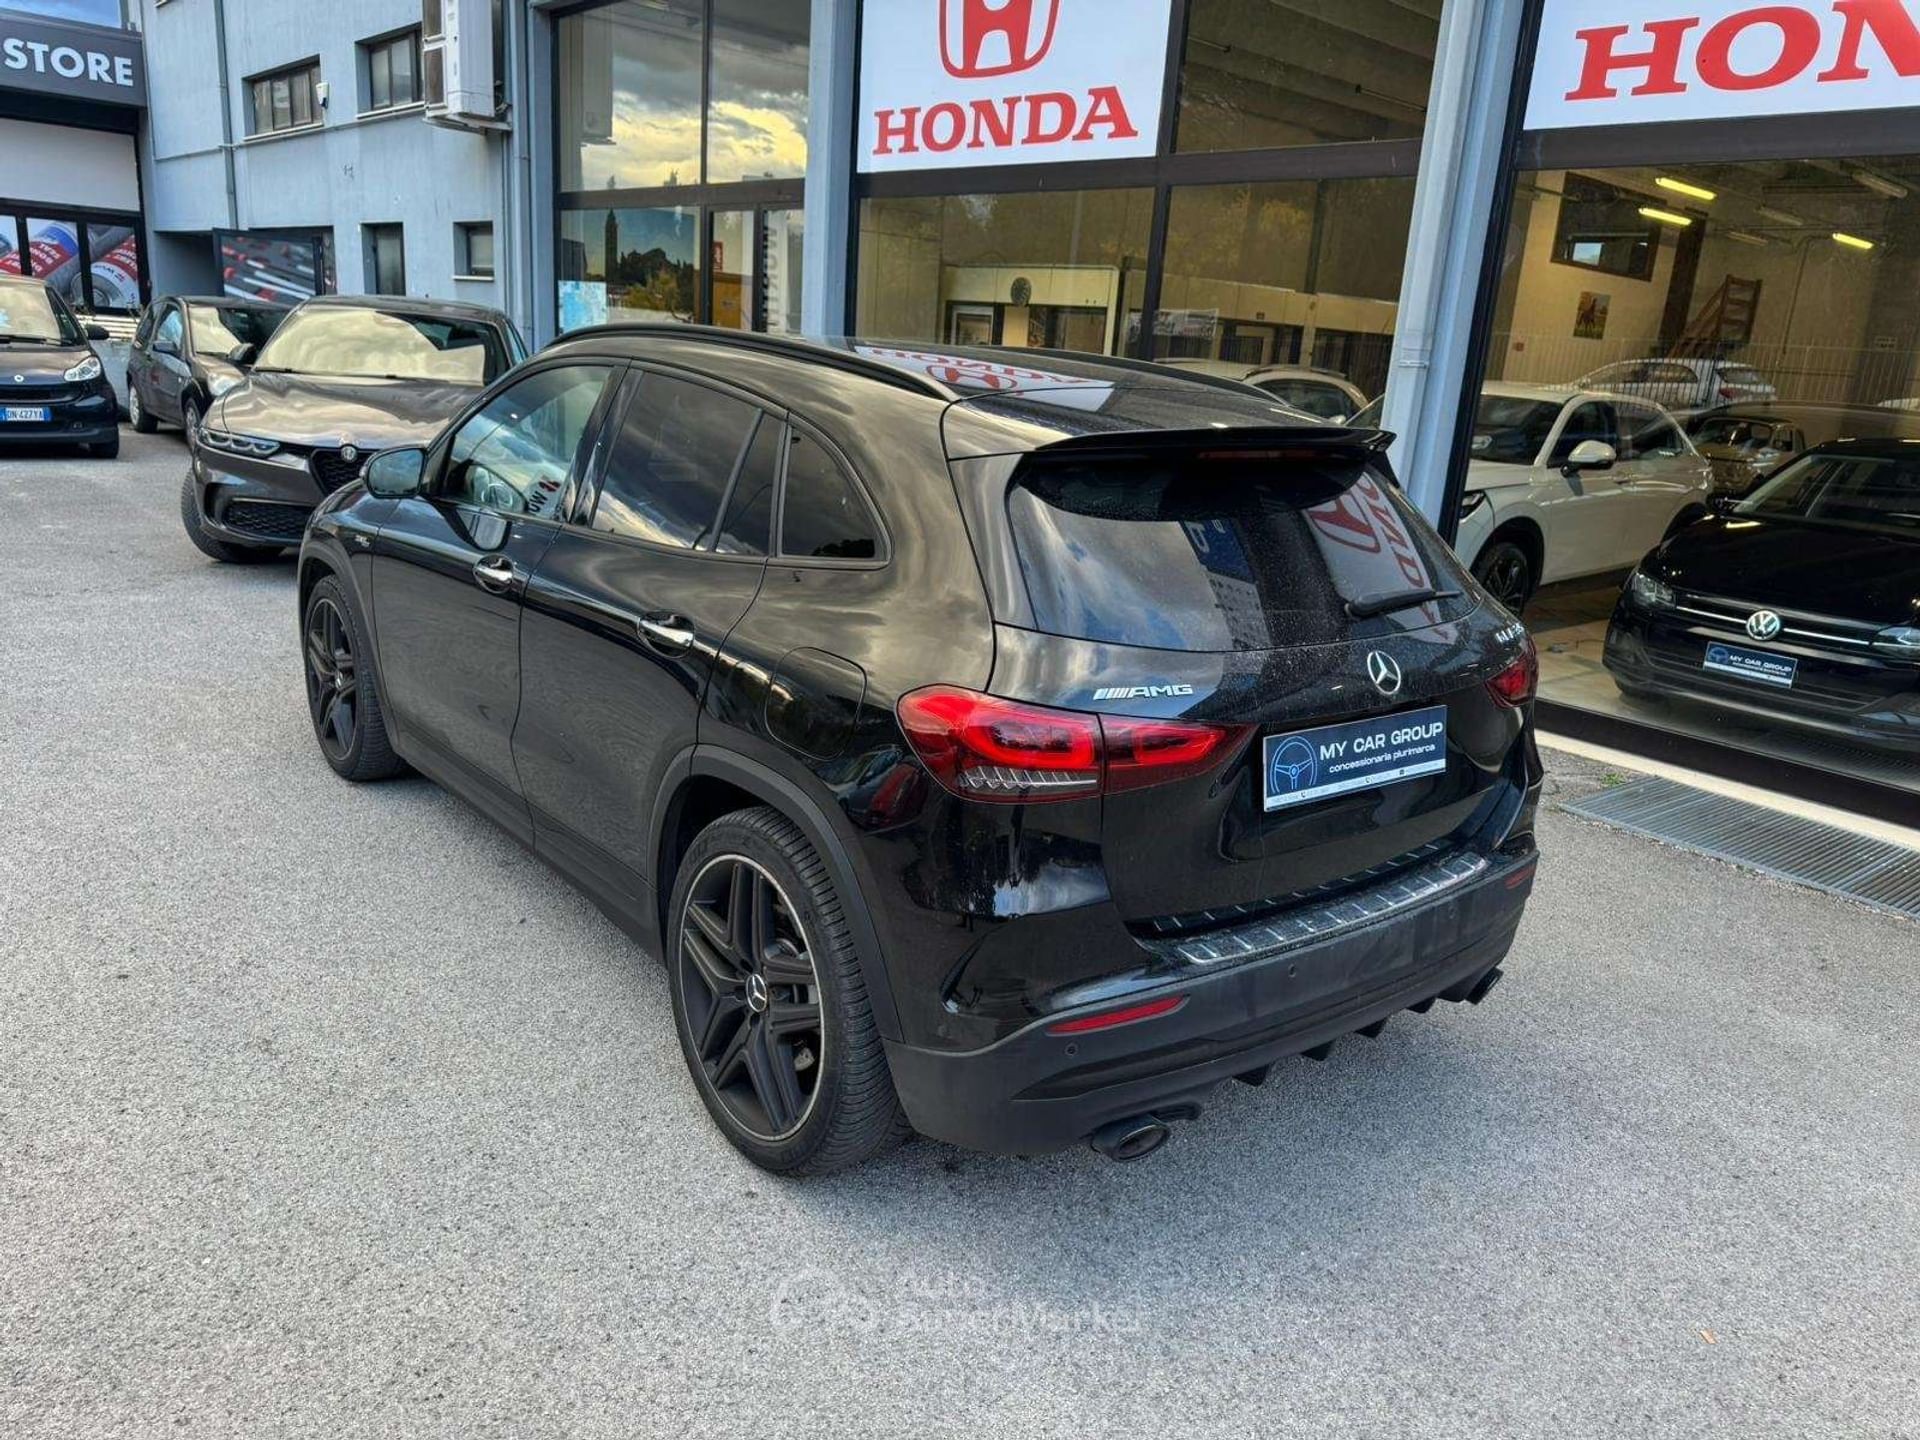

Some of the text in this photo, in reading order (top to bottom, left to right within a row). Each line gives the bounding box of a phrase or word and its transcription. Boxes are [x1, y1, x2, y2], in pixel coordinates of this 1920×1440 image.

[3, 38, 134, 87] STORE
[872, 86, 1138, 155] HONDA
[1744, 658, 1762, 666] CAR
[1763, 662, 1792, 672] GROUP
[1319, 722, 1443, 760] MY CAR GROUP
[1329, 743, 1436, 773] concessionaria plurimarca
